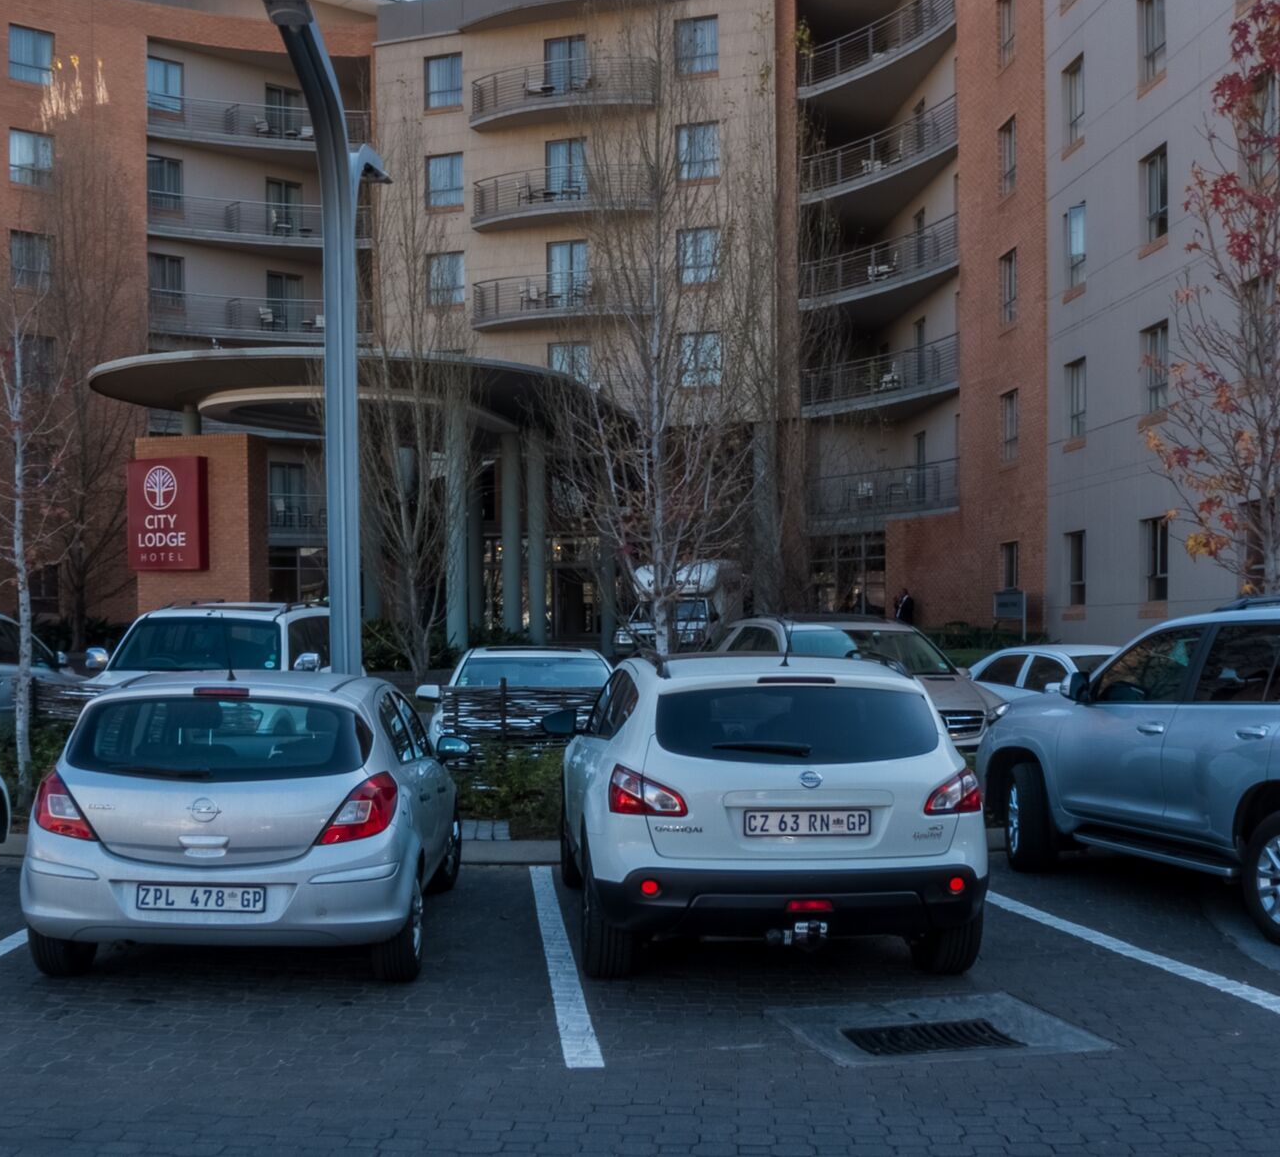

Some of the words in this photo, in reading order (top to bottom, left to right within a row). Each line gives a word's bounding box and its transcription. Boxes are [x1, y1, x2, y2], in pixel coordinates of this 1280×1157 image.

[144, 514, 177, 529] CITY
[138, 532, 186, 547] LODGE
[141, 552, 183, 562] HOTEL
[748, 814, 769, 833] CZ
[778, 814, 800, 832] 63
[808, 814, 830, 832] RN
[846, 813, 867, 831] GP
[140, 888, 175, 906] ZPL
[190, 889, 225, 907] 478
[241, 890, 262, 909] GP
